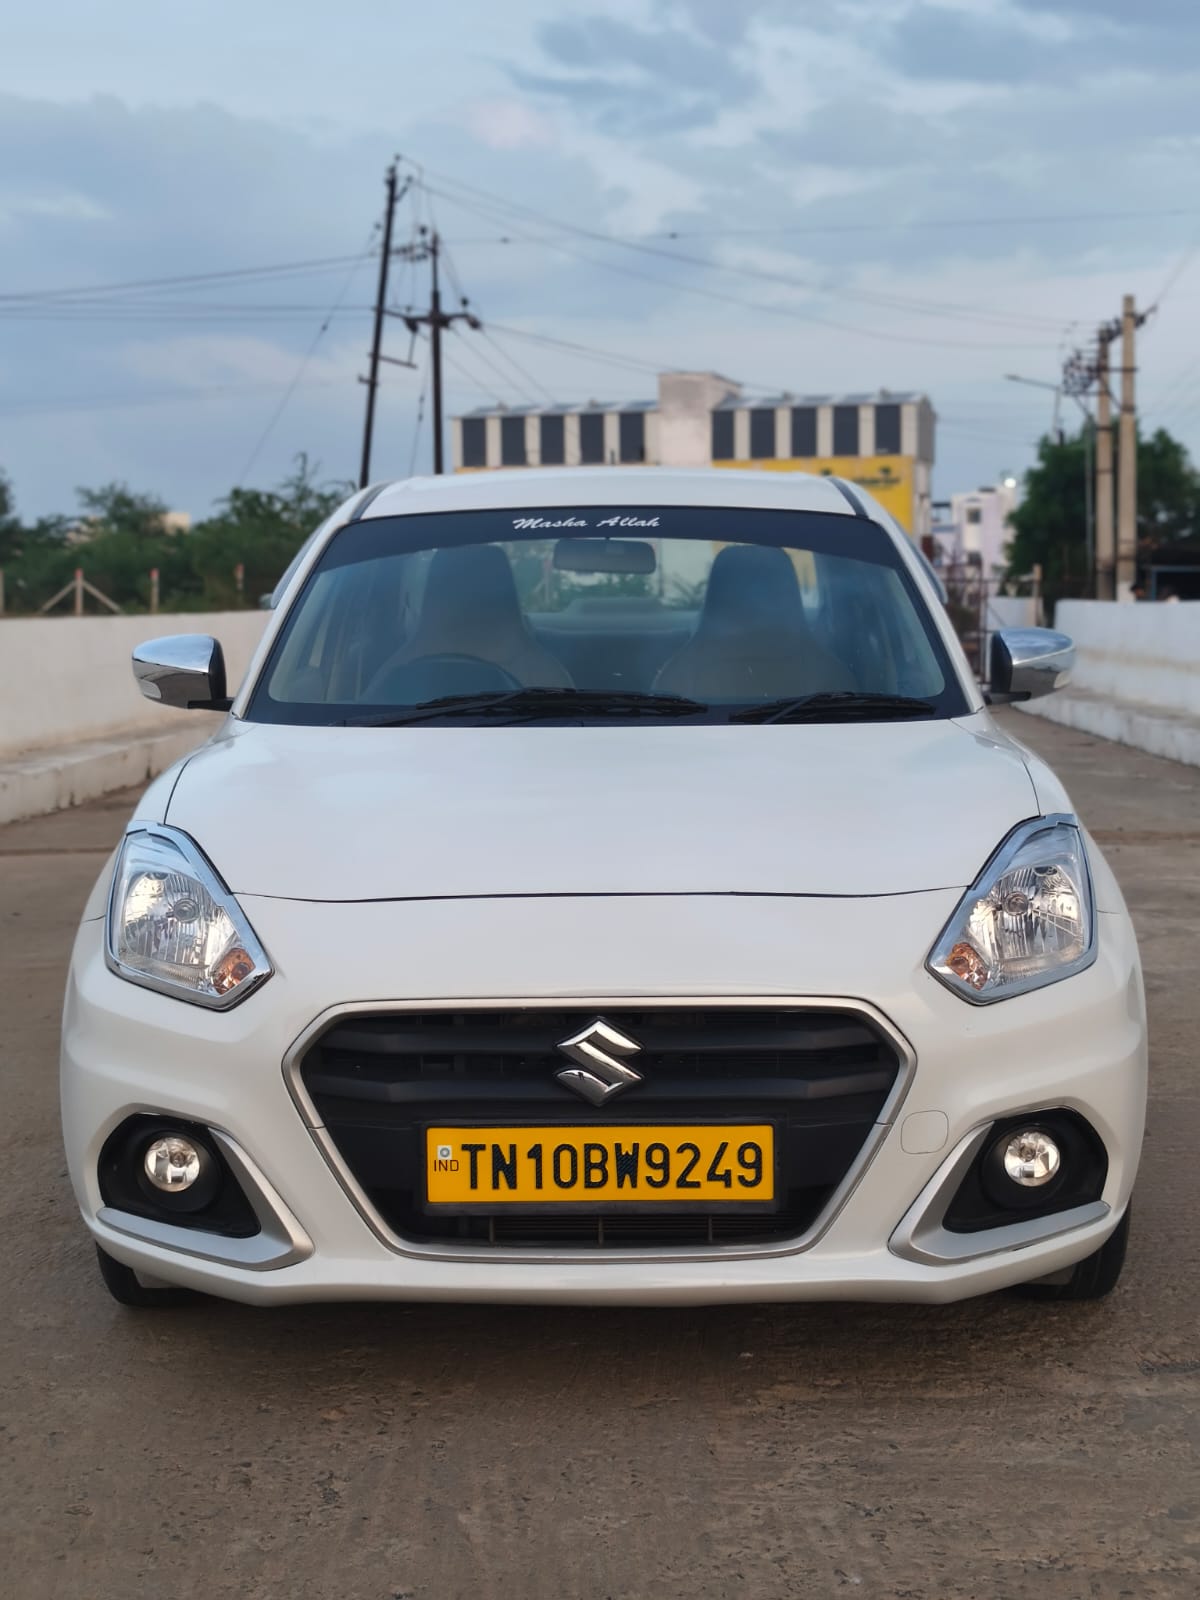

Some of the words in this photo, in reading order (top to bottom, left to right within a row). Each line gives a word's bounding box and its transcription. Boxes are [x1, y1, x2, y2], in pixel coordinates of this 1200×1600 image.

[512, 517, 588, 529] Masha
[596, 515, 660, 528] Allah
[433, 1159, 460, 1172] IND
[461, 1142, 763, 1190] TN10BW9249
